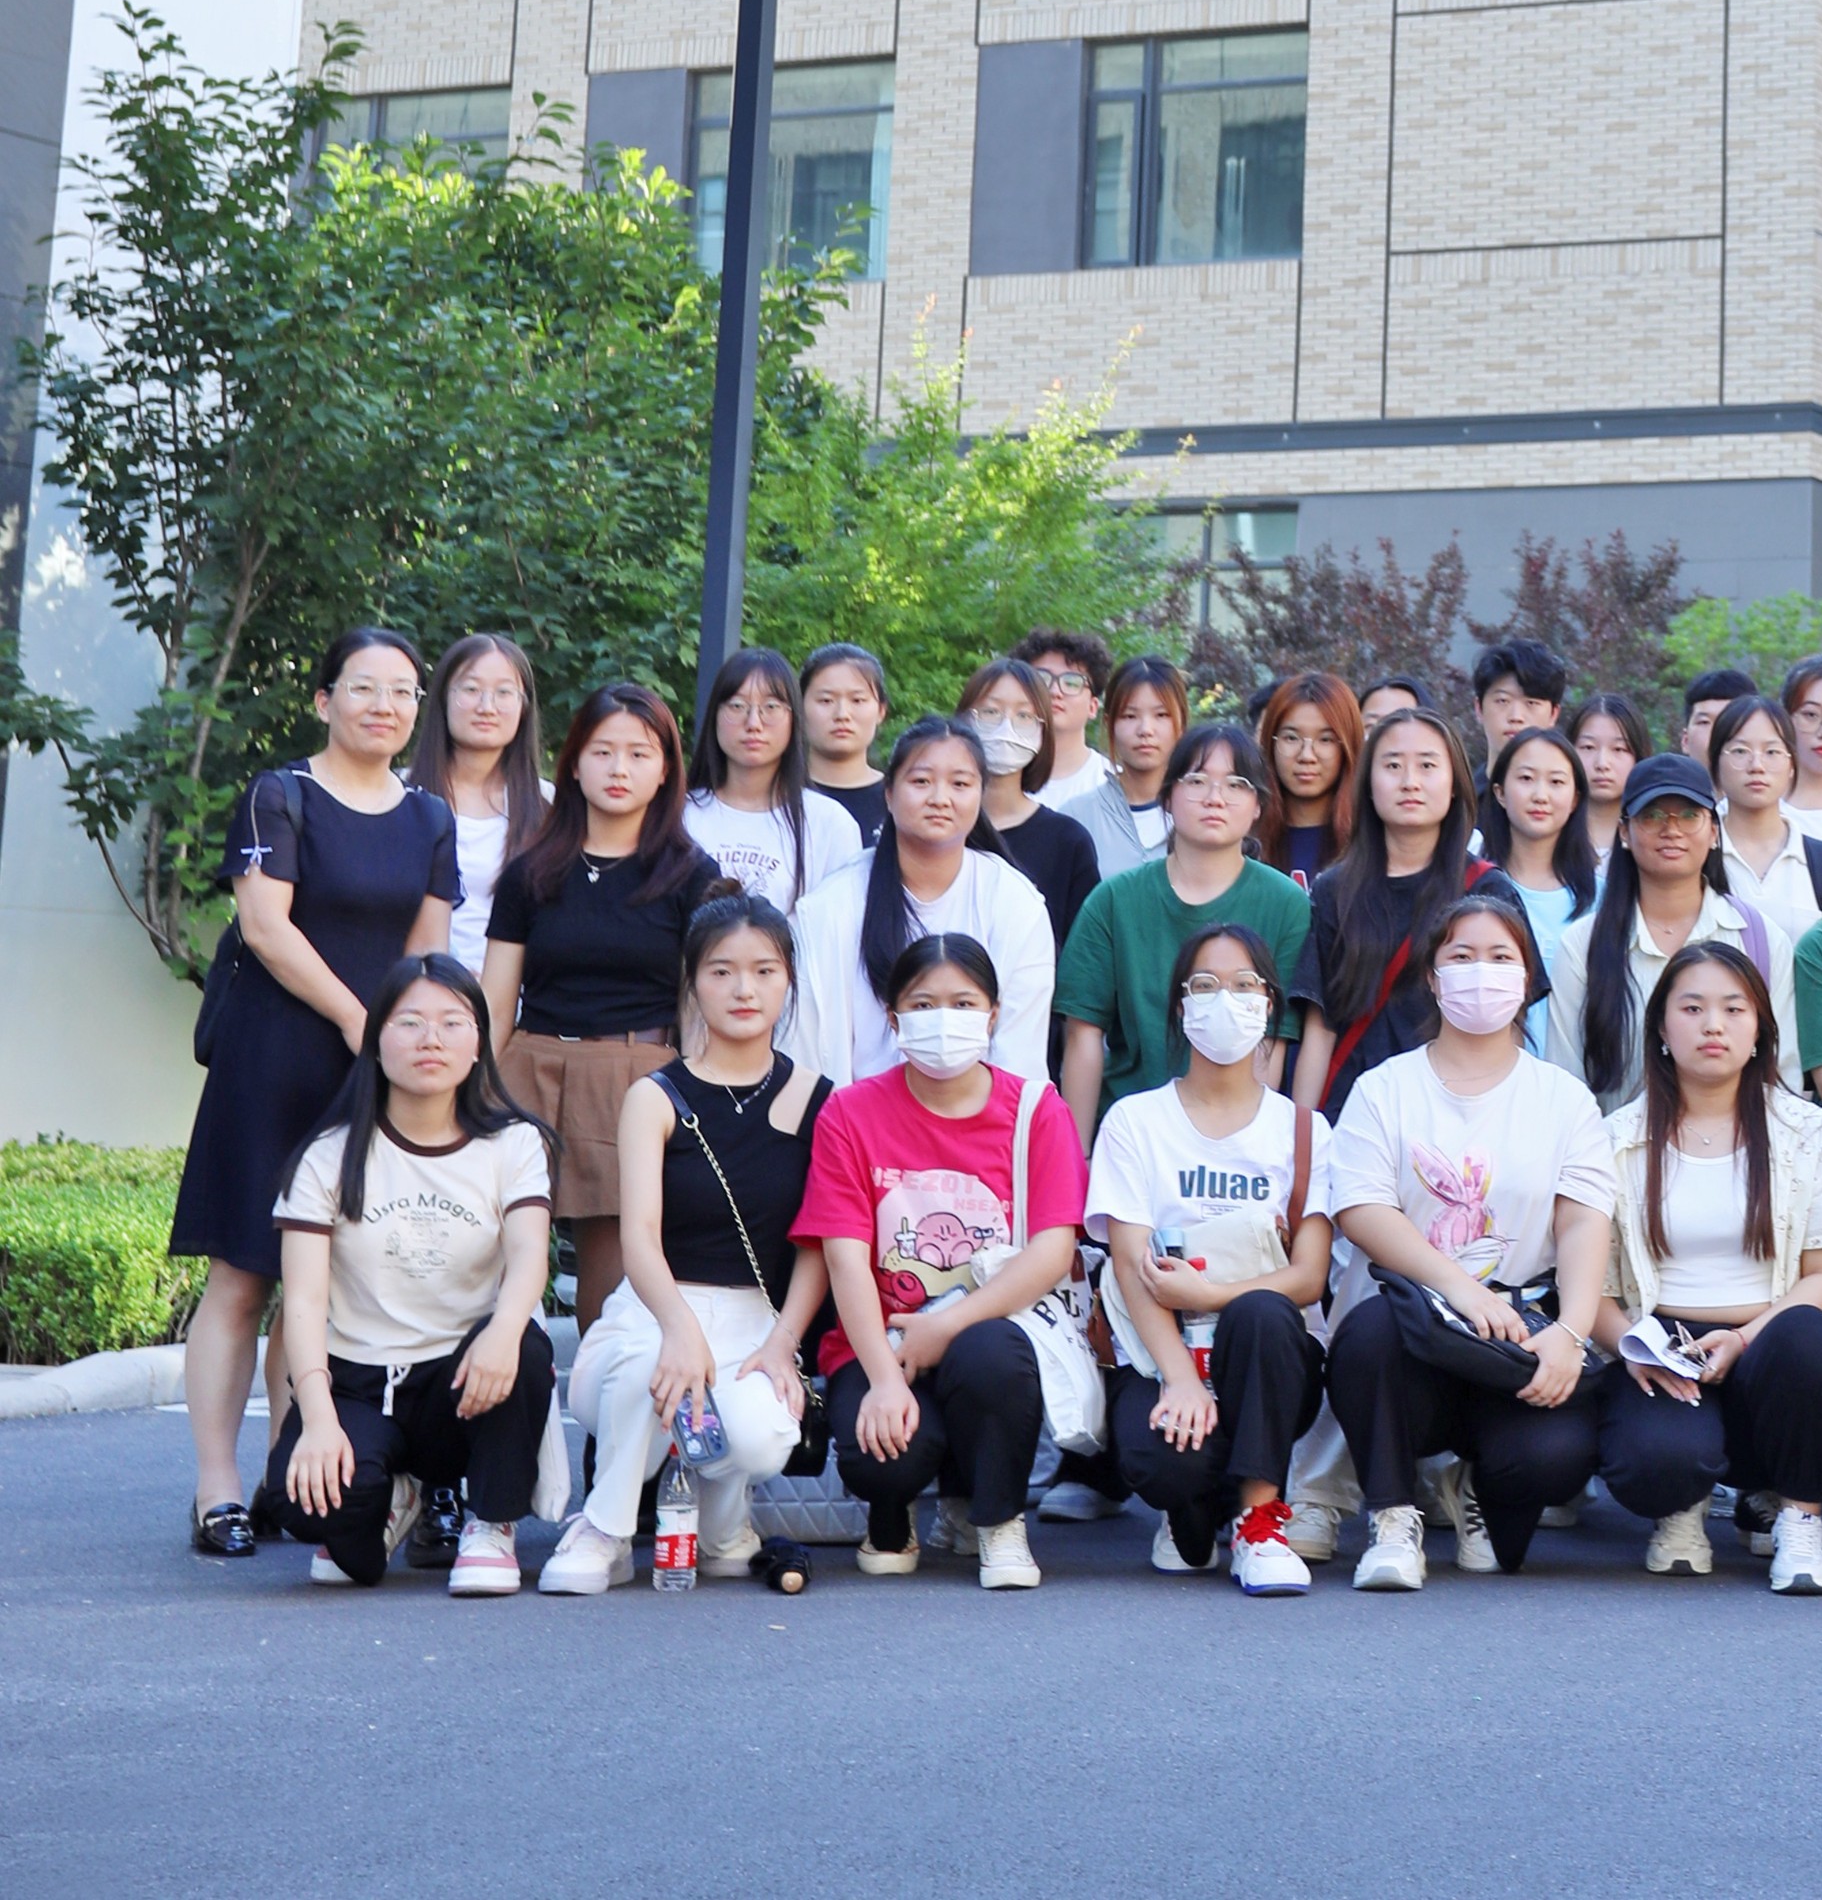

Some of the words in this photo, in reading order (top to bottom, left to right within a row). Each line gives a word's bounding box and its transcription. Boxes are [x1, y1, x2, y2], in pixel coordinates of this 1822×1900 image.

[709, 851, 781, 871] LICIOUS
[1178, 1165, 1270, 1201] vluae
[417, 1192, 482, 1227] Magor
[953, 1196, 1014, 1214] NSEZO
